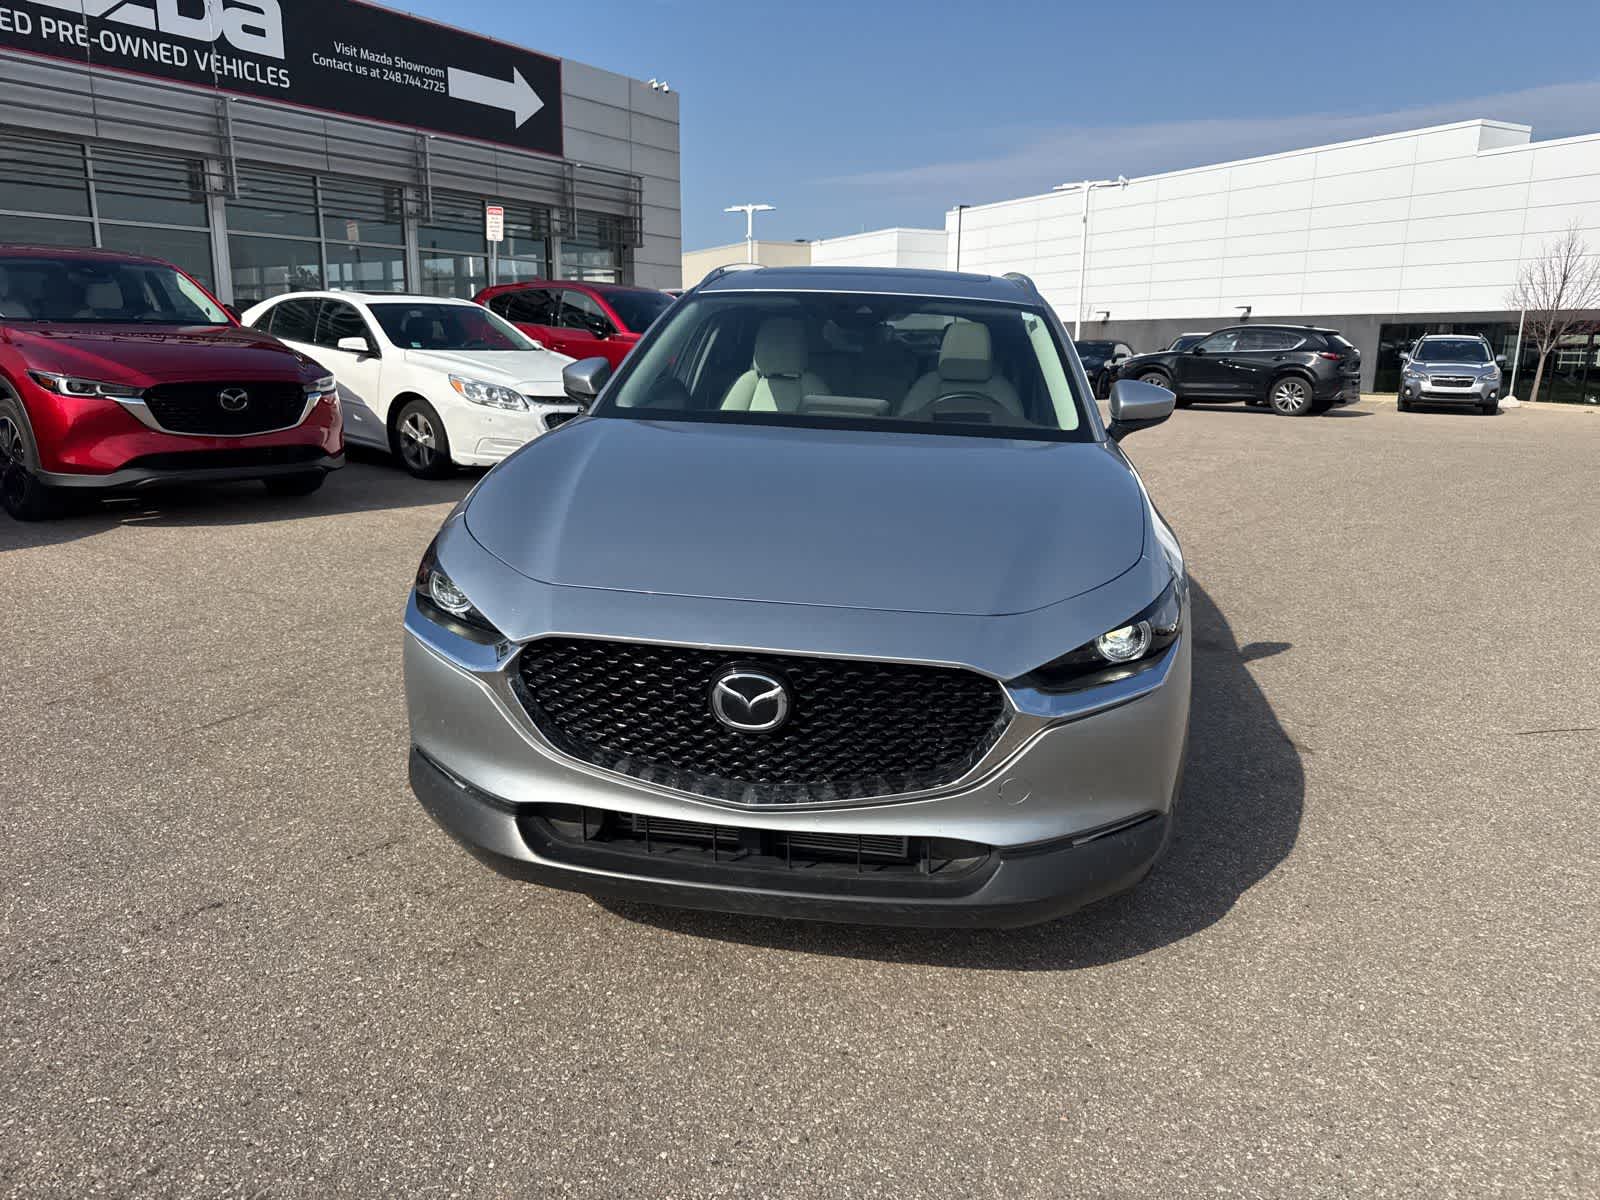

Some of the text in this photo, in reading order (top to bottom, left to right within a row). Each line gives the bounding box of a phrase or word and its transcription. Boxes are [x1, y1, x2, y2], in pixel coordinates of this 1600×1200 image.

[40, 17, 188, 67] PRE-OWNED
[194, 49, 290, 88] VEHICLES
[333, 41, 445, 78] Visit Mazda Showroom
[312, 53, 446, 93] Contact us at 248.744.2725
